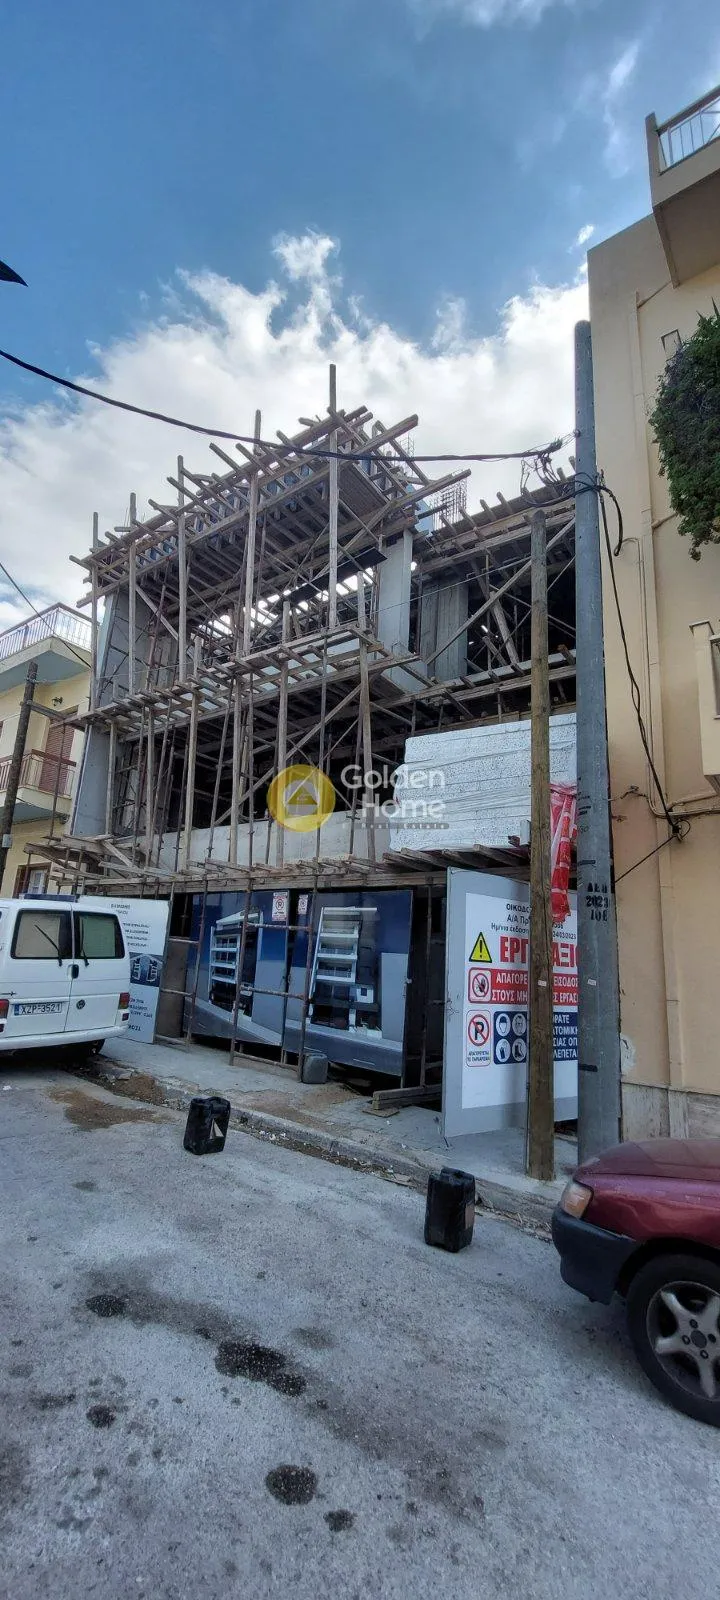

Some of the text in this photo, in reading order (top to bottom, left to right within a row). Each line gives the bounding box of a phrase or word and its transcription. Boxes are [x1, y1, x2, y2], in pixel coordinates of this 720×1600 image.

[506, 903, 530, 914] ΟΙΚΟΔΟ
[520, 916, 529, 926] Πρ
[496, 972, 528, 985] ΑΠΑΓΟΡΕ
[491, 989, 515, 1002] ΣΤΟΥΣ
[559, 992, 578, 1003] ΕΡΓΑΣΙ
